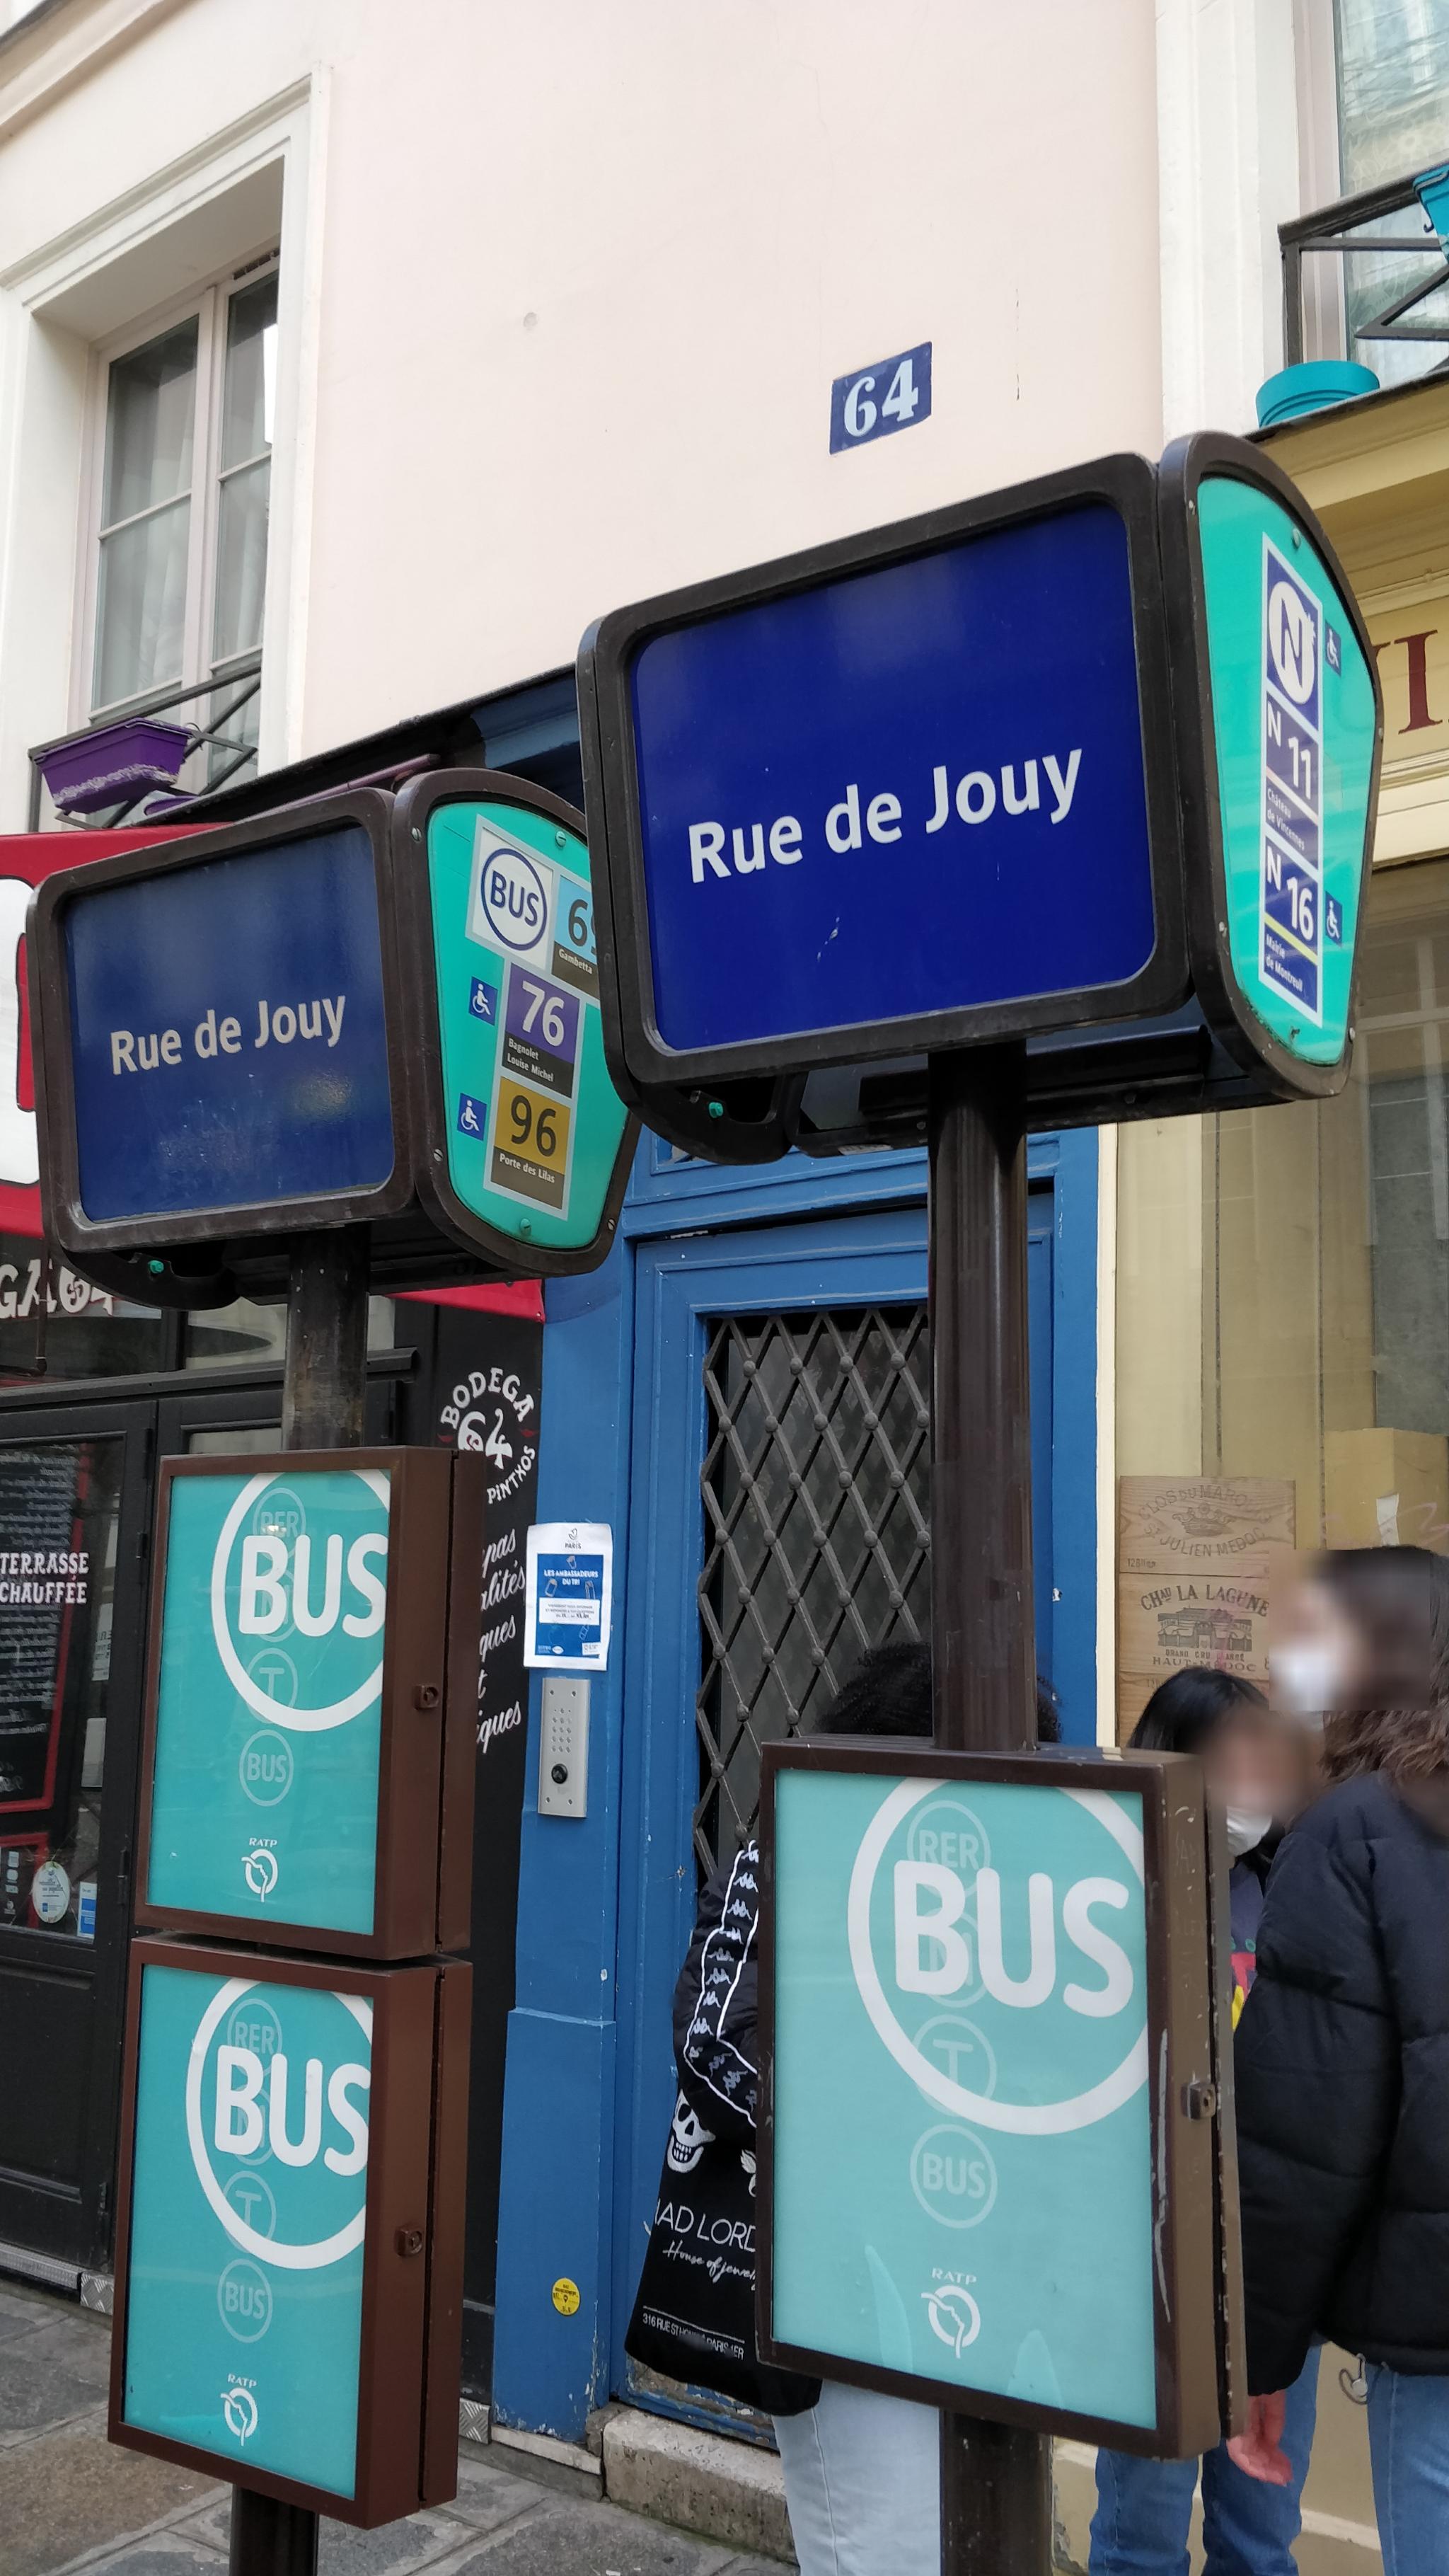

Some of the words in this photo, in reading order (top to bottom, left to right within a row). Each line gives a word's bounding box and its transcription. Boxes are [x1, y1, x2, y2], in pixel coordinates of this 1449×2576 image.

[844, 358, 918, 438] 64
[1267, 701, 1281, 747] N
[1288, 736, 1311, 800] 11
[688, 821, 803, 884] Rue
[825, 783, 903, 854] de
[925, 748, 1083, 834] Jouy
[1276, 815, 1305, 851] Vincennes
[490, 870, 540, 927] BUS
[1266, 845, 1282, 892] N
[1286, 876, 1314, 941] 16
[567, 898, 597, 955] 6
[1266, 933, 1286, 959] Mairie
[558, 948, 593, 975] Gambetta
[1275, 960, 1303, 992] Montreuil
[522, 980, 565, 1047] 76
[110, 1029, 182, 1076] Rue
[195, 1009, 242, 1059] de
[255, 995, 345, 1048] Jouy
[509, 1037, 539, 1061] Bagnolet
[507, 1052, 530, 1071] Louise
[531, 1064, 555, 1083] Michel
[511, 1095, 557, 1157] 96
[500, 1153, 521, 1170] Porte
[523, 1163, 536, 1175] des
[538, 1168, 555, 1184] Lilas
[440, 1367, 535, 1430] BODEGA
[458, 1408, 513, 1470] 64
[486, 1445, 536, 1505] PINTXOS
[0, 1552, 89, 1575] TERRASSE
[482, 1528, 516, 1579] pas
[1160, 1536, 1213, 1557] JULIEN
[238, 1533, 388, 1638] BUS
[1177, 1585, 1199, 1602] LA
[1206, 1585, 1269, 1617] LAGUNE
[246, 1752, 287, 1783] BUS
[249, 1837, 277, 1848] RATP
[919, 1829, 980, 1870] RER
[893, 1859, 1133, 2018] BUS
[234, 2021, 275, 2055] RER
[214, 2045, 371, 2178] BUS
[923, 2152, 986, 2199] BUS
[662, 2239, 705, 2265] House
[706, 2255, 723, 2277] of
[931, 2267, 978, 2285] RATP
[225, 2281, 266, 2320] BUS
[642, 2312, 657, 2328] 316
[657, 2317, 671, 2335] RUE
[227, 2372, 258, 2389] RATP
